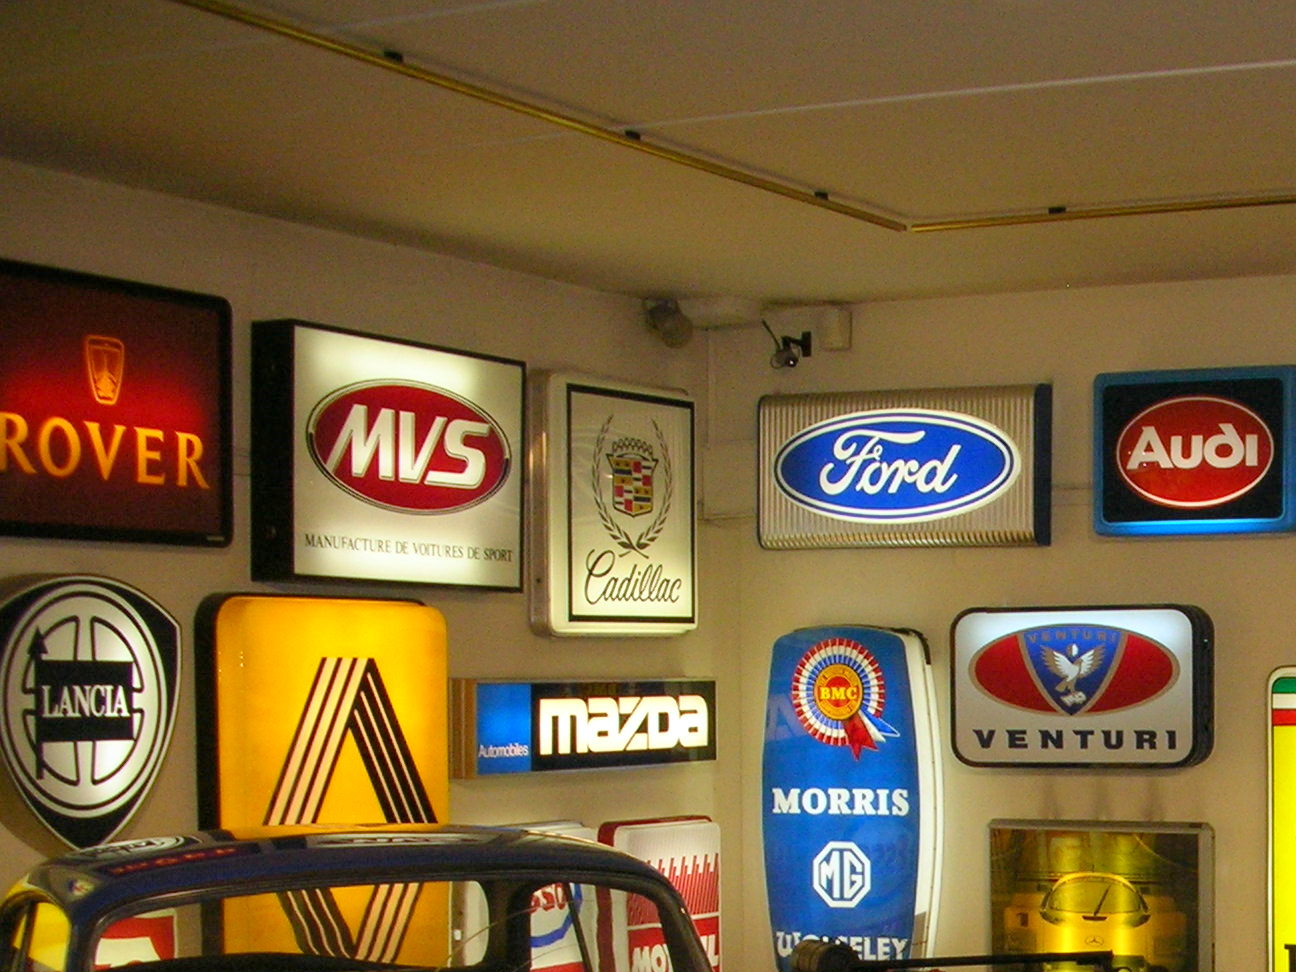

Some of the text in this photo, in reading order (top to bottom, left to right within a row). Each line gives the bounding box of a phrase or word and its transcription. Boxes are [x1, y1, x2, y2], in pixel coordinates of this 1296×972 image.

[0, 410, 211, 489] ROVER
[325, 403, 492, 490] MVS
[819, 428, 962, 496] Ford
[1126, 422, 1259, 471] Audi
[304, 533, 513, 563] MANUFACTURE DE VOITURES DE SPORT
[584, 548, 683, 606] Cadillac
[1027, 630, 1118, 644] VENTURI
[41, 684, 131, 718] LANCIA
[819, 686, 858, 701] BMC
[478, 742, 529, 759] Automobiles
[972, 729, 1178, 751] VENTURI
[772, 787, 910, 817] MORRIS
[820, 850, 864, 900] MG
